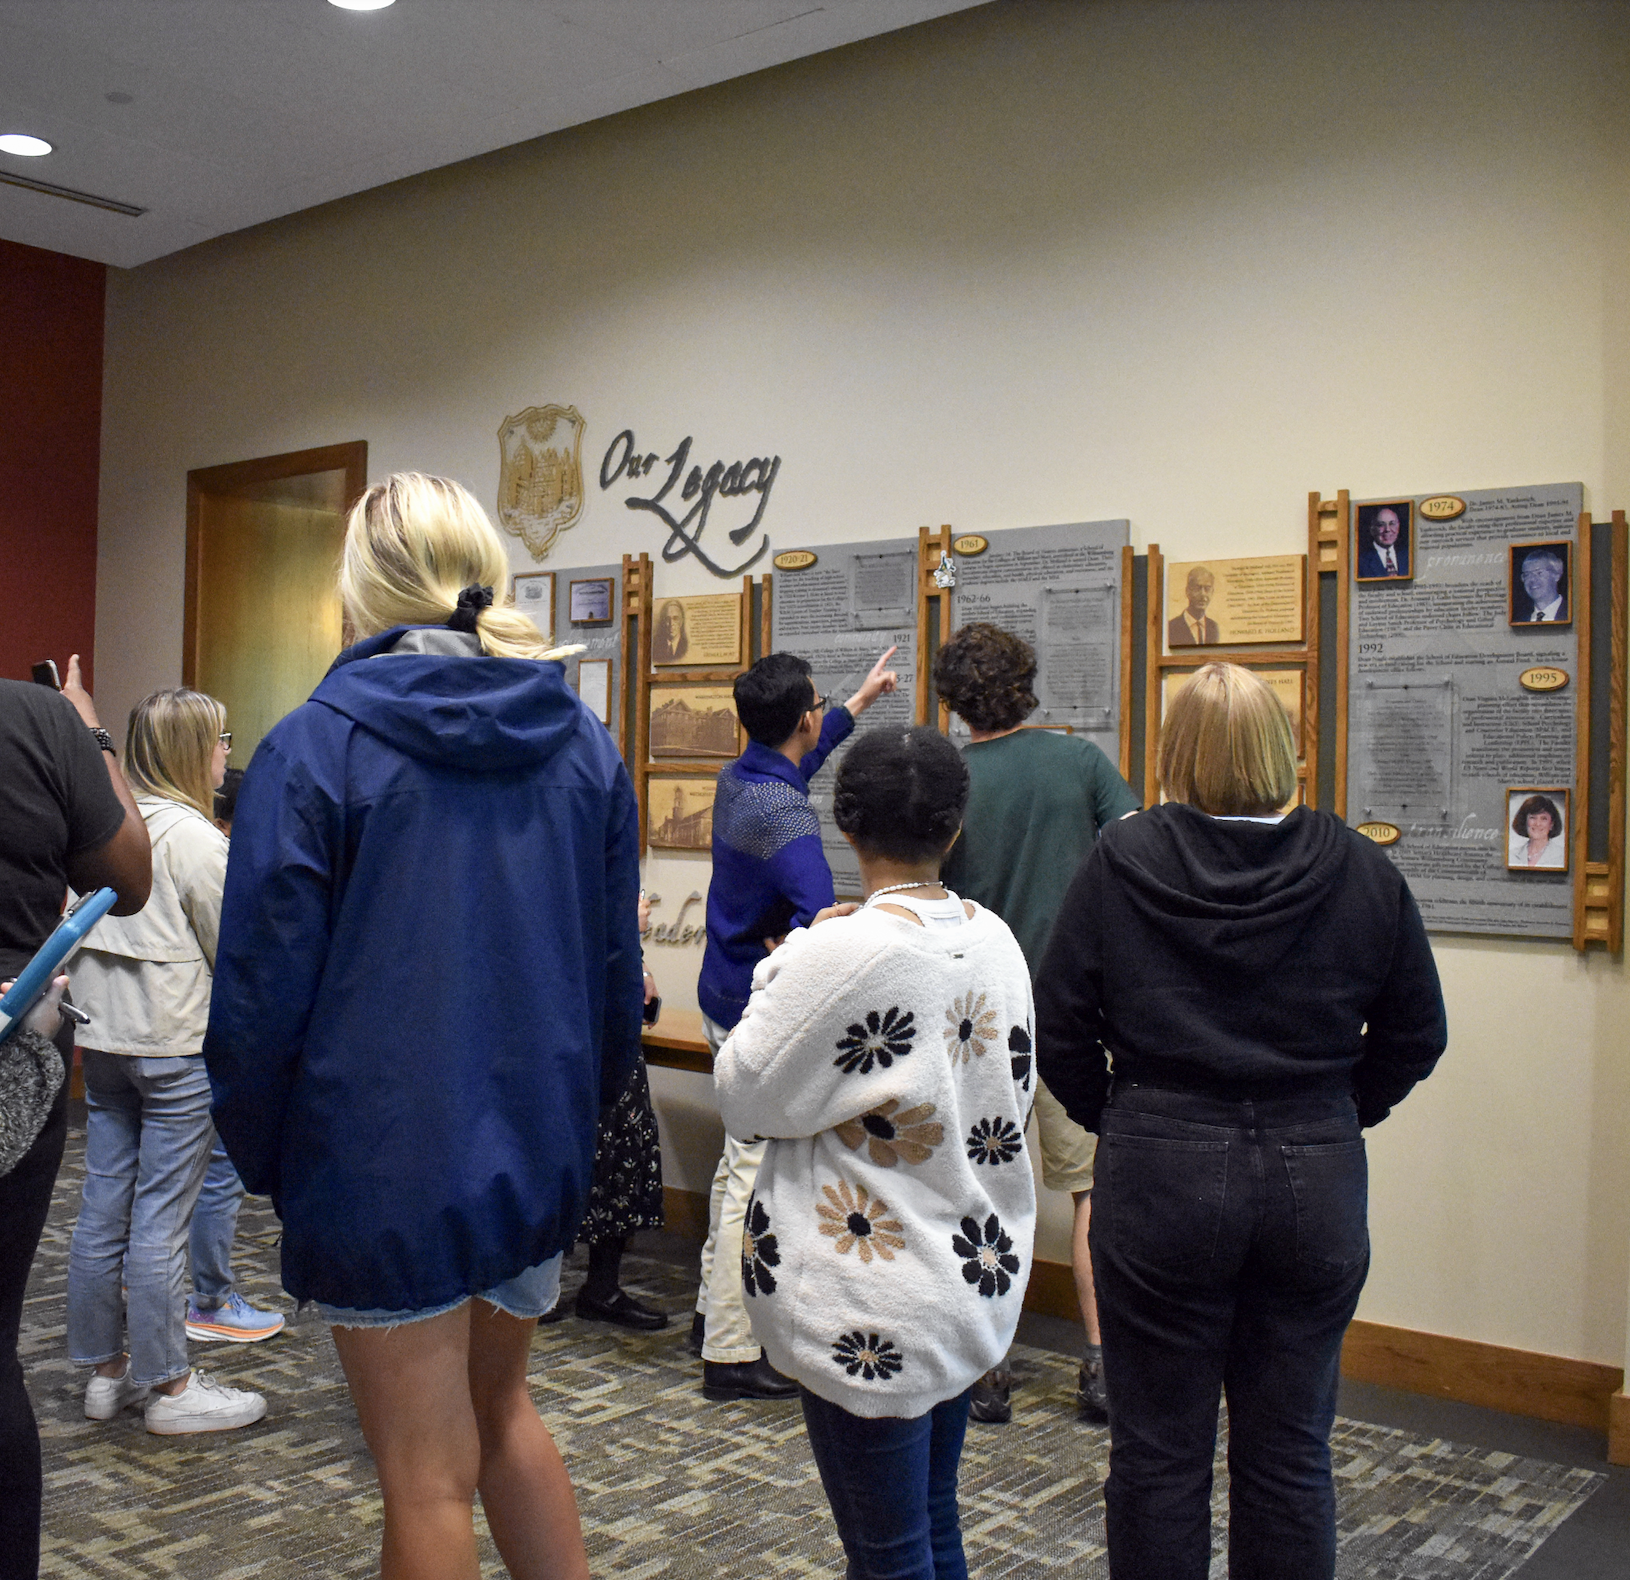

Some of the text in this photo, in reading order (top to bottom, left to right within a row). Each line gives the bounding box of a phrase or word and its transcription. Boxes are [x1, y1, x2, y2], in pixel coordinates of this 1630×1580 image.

[600, 429, 782, 579] Our Legacy
[1429, 501, 1454, 512] 1974
[960, 539, 979, 549] 1961
[780, 554, 809, 564] 1920-21
[957, 594, 991, 603] 1962-66
[893, 634, 911, 643] 1921
[1358, 643, 1384, 654] 1992
[1530, 673, 1557, 683] 1995
[1364, 827, 1390, 838] 2010
